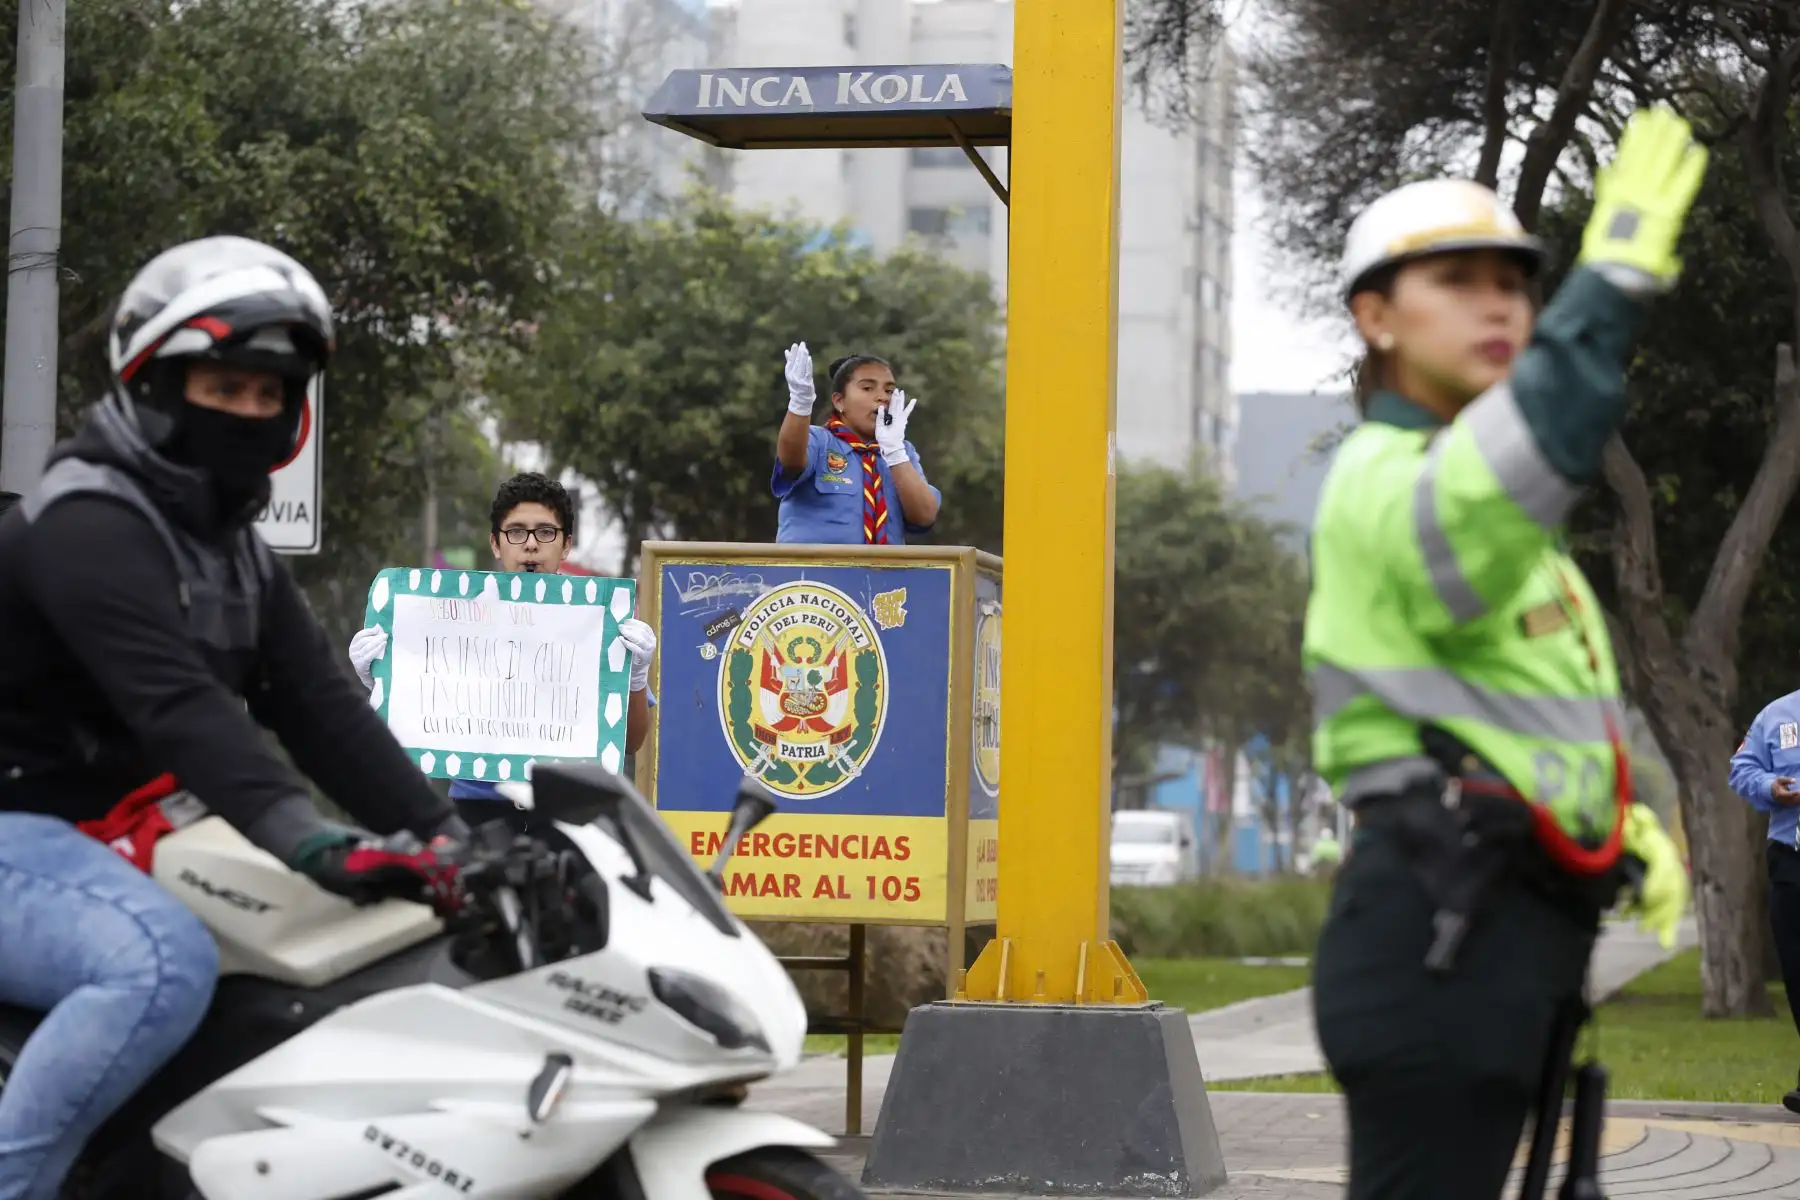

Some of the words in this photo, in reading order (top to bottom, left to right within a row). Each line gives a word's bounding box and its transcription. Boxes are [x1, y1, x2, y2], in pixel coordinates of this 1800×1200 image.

[696, 74, 813, 108] INCA
[835, 71, 969, 105] KOLA
[744, 596, 795, 641] POLICIA
[800, 594, 864, 643] NACIONAL
[774, 615, 798, 632] DEL
[802, 614, 835, 632] PERU
[781, 743, 826, 758] PATRIA
[691, 831, 911, 861] EMERGENCIAS
[812, 875, 851, 900] AL
[867, 875, 921, 902] 105
